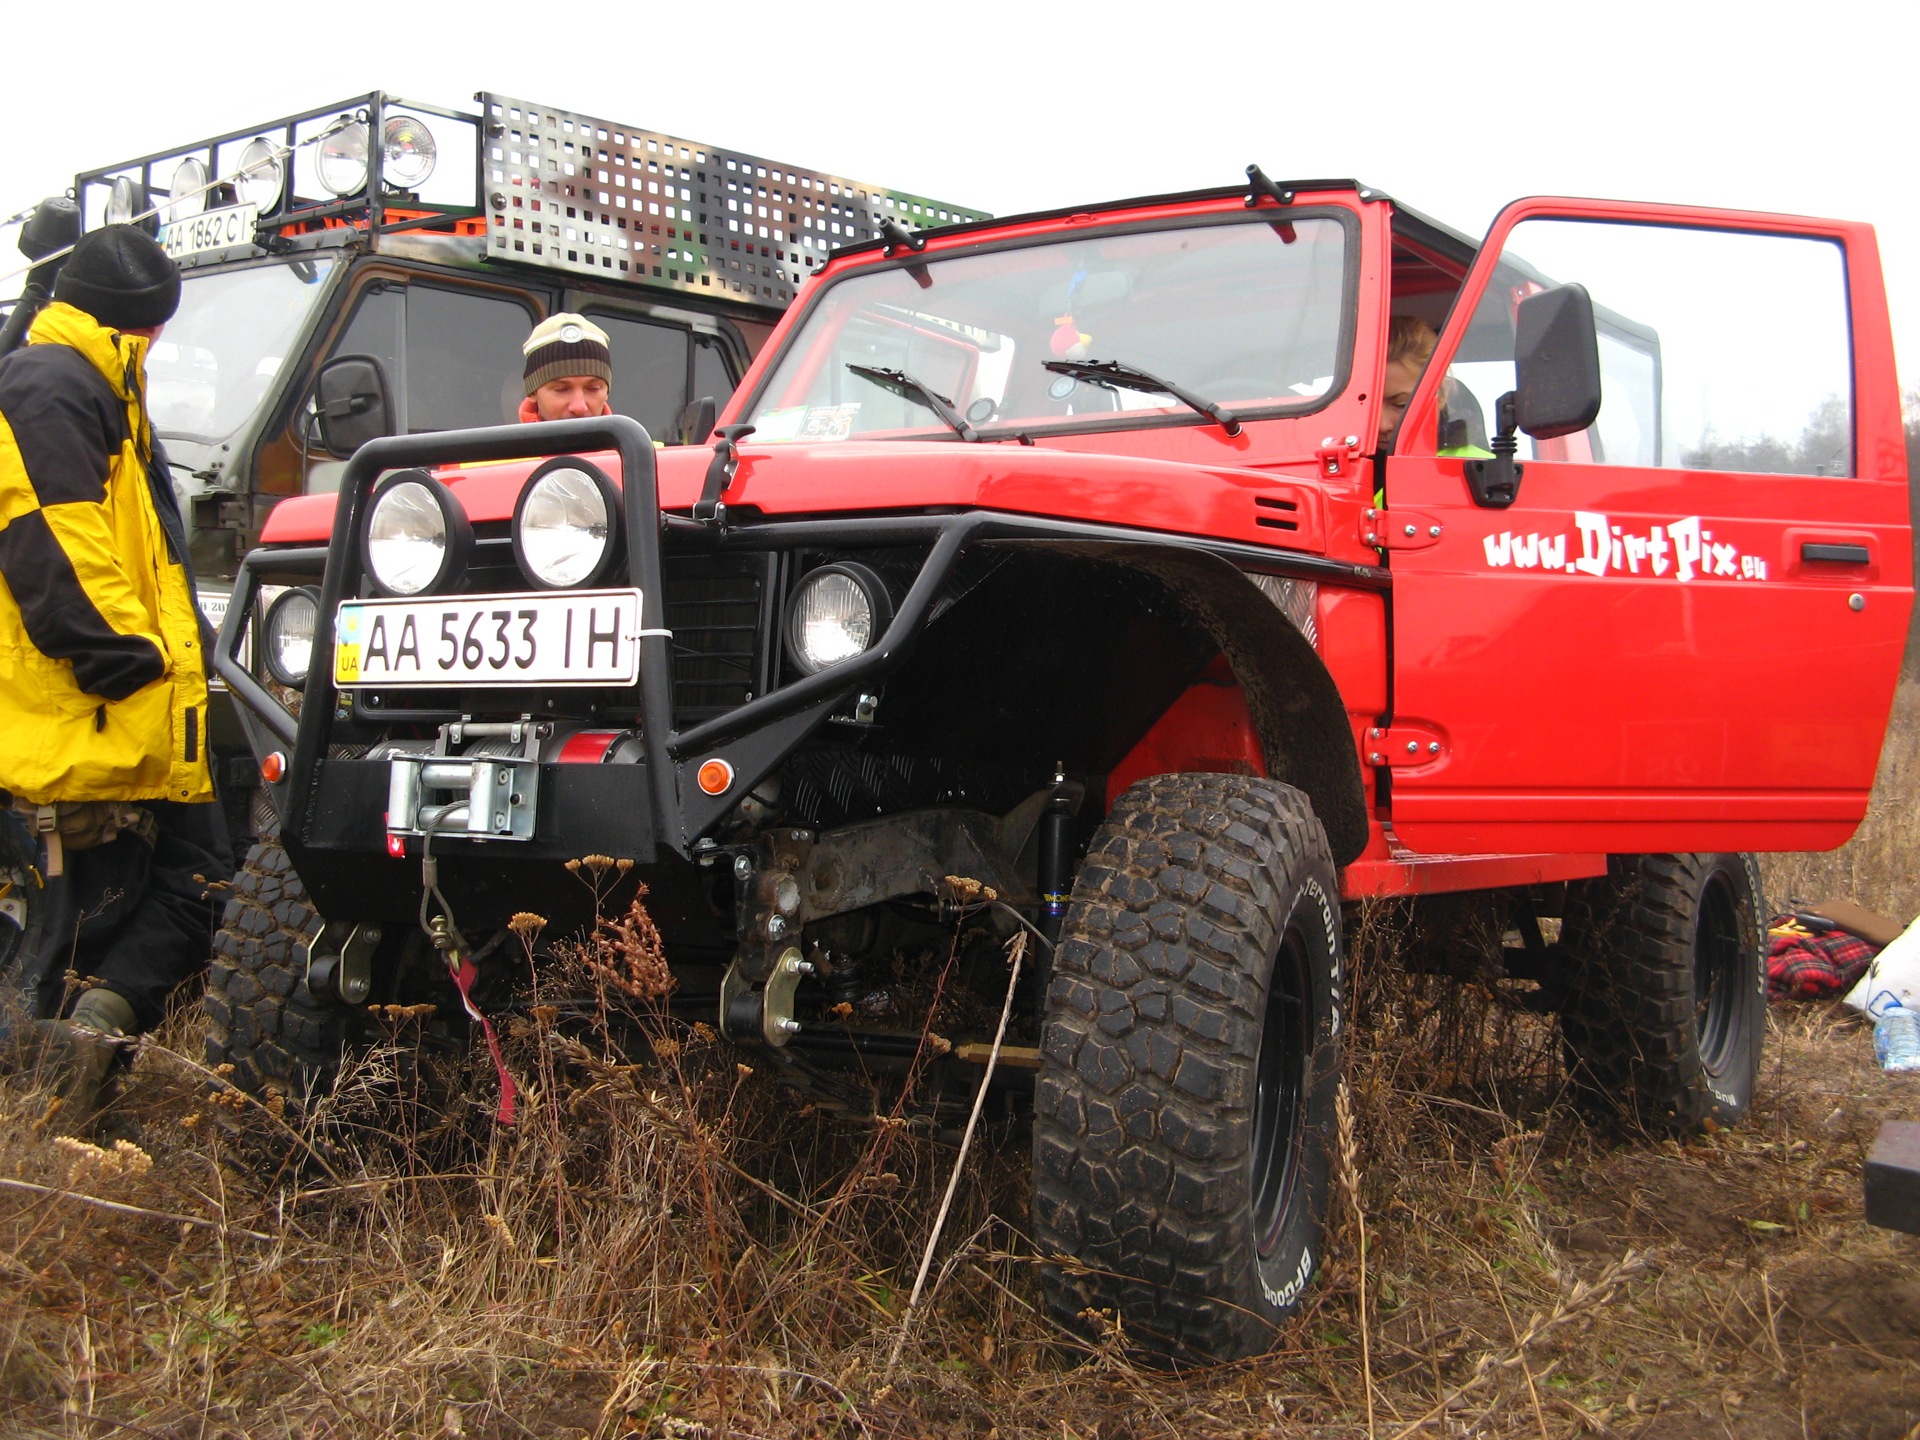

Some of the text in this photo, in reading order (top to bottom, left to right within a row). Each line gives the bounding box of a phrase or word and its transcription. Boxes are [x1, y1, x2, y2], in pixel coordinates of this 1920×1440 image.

[165, 211, 246, 255] AA 1862 CI
[1483, 511, 1767, 583] www.DirtPix.eu
[341, 656, 358, 672] UA
[363, 607, 621, 671] AA 5633 IH
